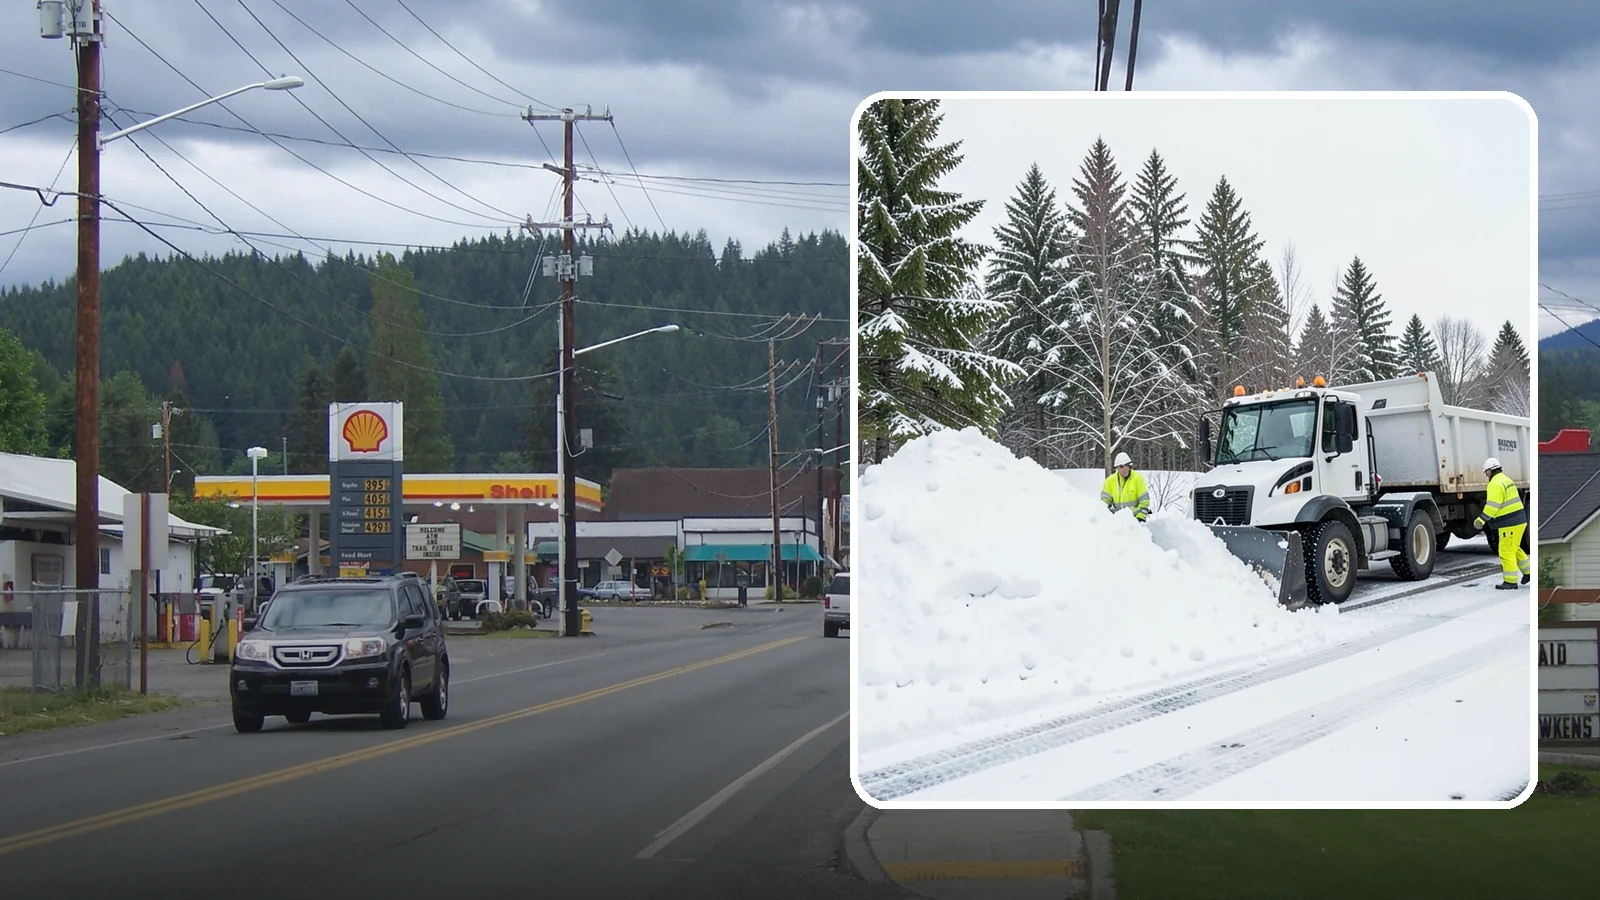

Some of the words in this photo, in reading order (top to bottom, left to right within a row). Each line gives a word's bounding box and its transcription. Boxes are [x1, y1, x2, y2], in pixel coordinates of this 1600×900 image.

[366, 480, 383, 490] 395
[490, 485, 547, 499] Shell
[366, 494, 383, 504] 405
[366, 508, 383, 518] 415
[366, 522, 383, 532] 429
